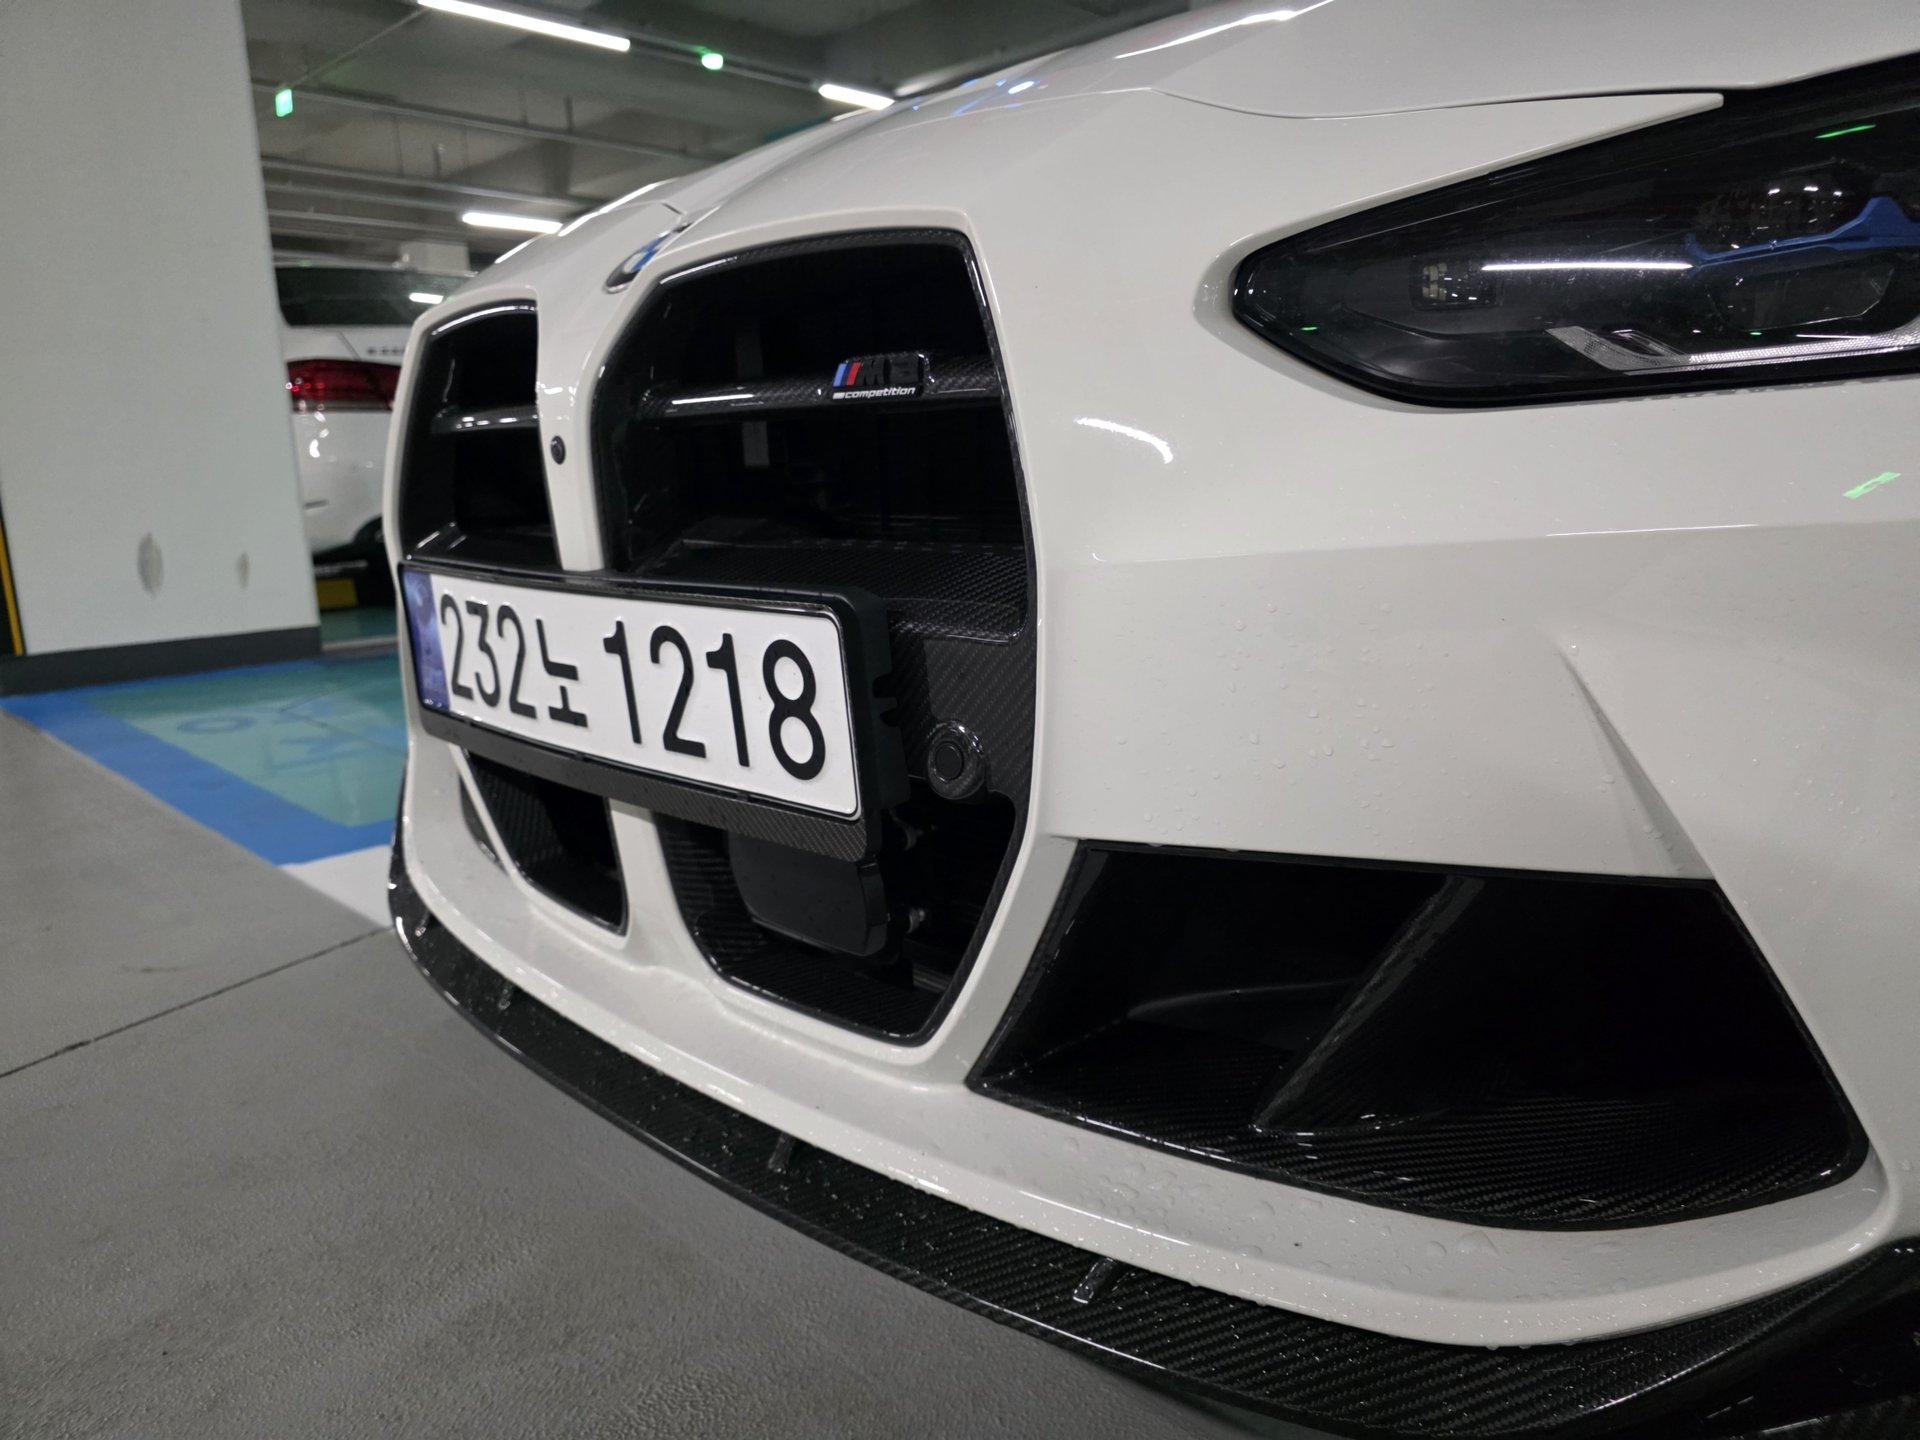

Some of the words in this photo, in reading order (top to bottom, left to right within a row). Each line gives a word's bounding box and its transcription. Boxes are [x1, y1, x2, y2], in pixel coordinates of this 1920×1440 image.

[844, 386, 916, 399] competition
[440, 594, 588, 728] 232노
[603, 620, 827, 781] 1218
